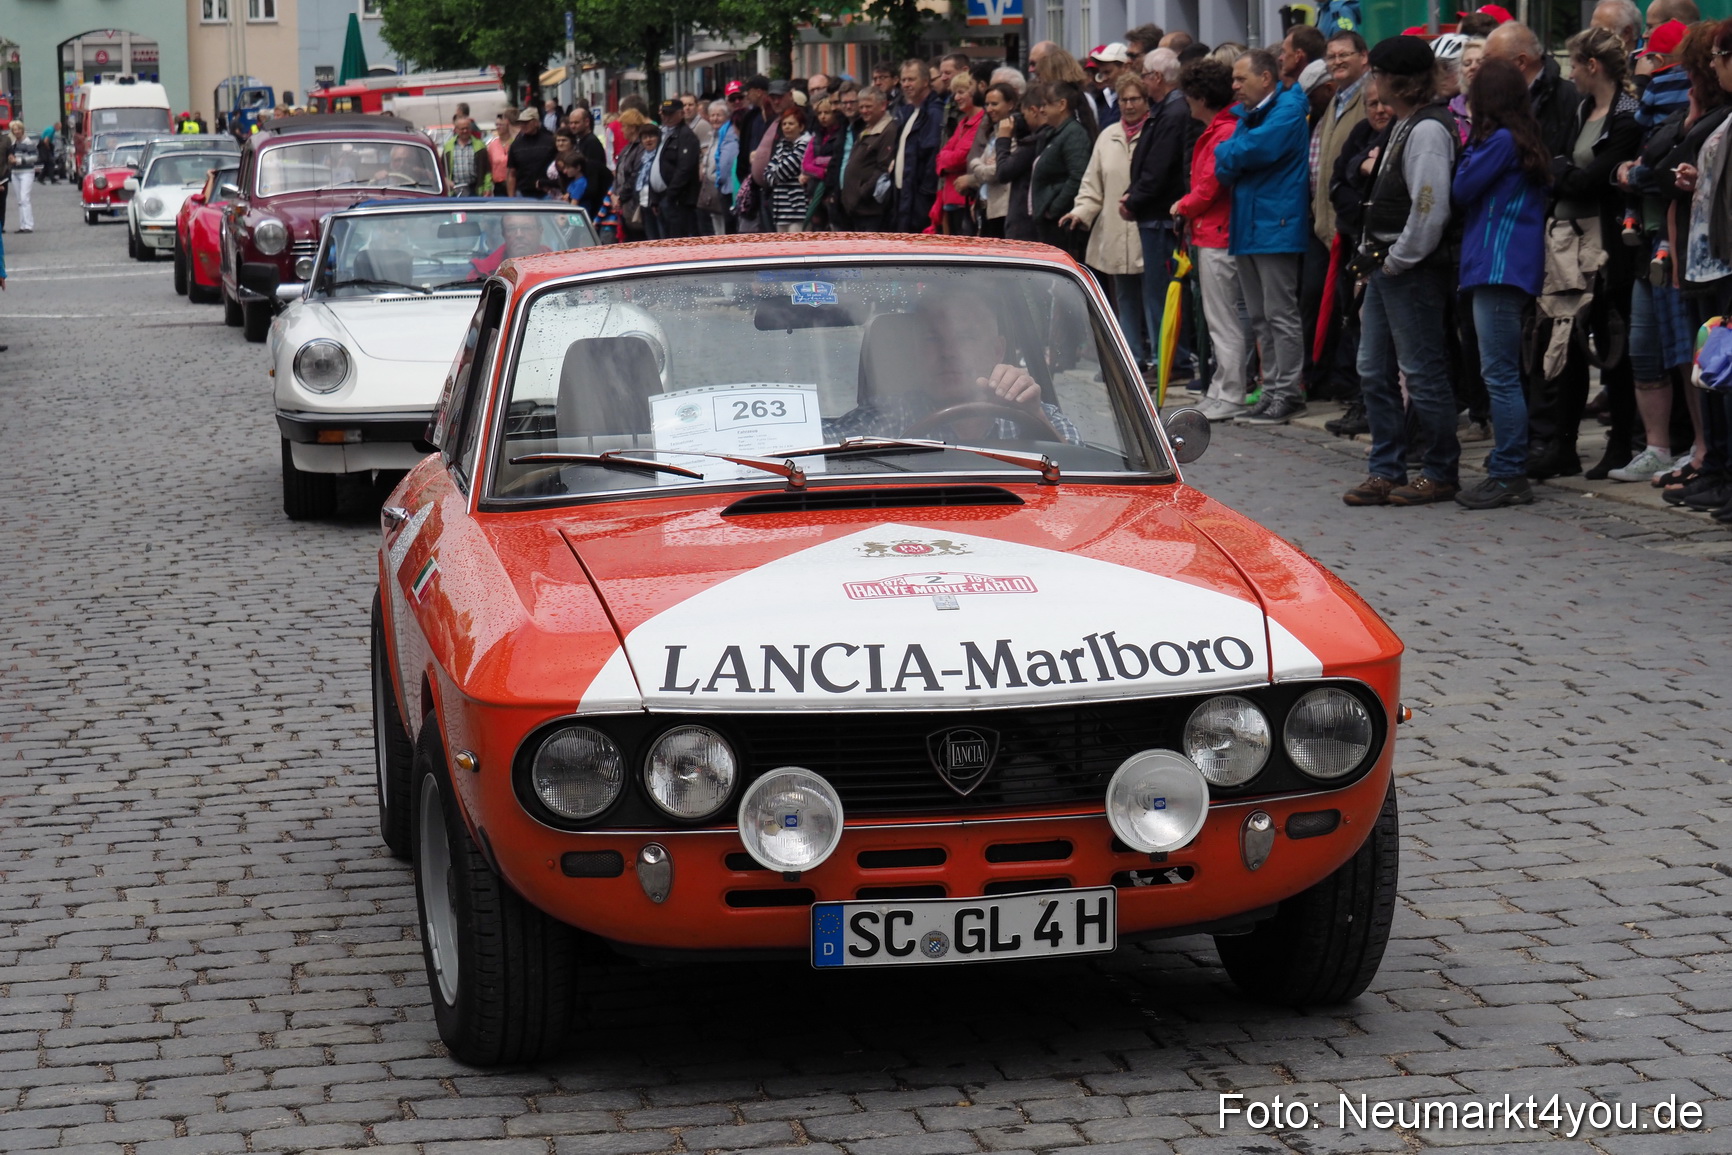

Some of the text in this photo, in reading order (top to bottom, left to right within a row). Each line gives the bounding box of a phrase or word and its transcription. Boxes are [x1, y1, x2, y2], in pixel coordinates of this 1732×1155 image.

[732, 400, 787, 421] 263
[850, 577, 1028, 598] RALLYE MONTE-CARLO
[880, 577, 907, 587] 1973
[924, 575, 945, 584] 2
[659, 630, 1254, 695] LANCIA-Marlboro
[951, 743, 983, 767] LANCIA
[848, 910, 916, 958] SC
[954, 906, 1021, 955] GL
[1033, 900, 1064, 948] 4
[1076, 896, 1109, 945] H
[823, 942, 835, 956] D
